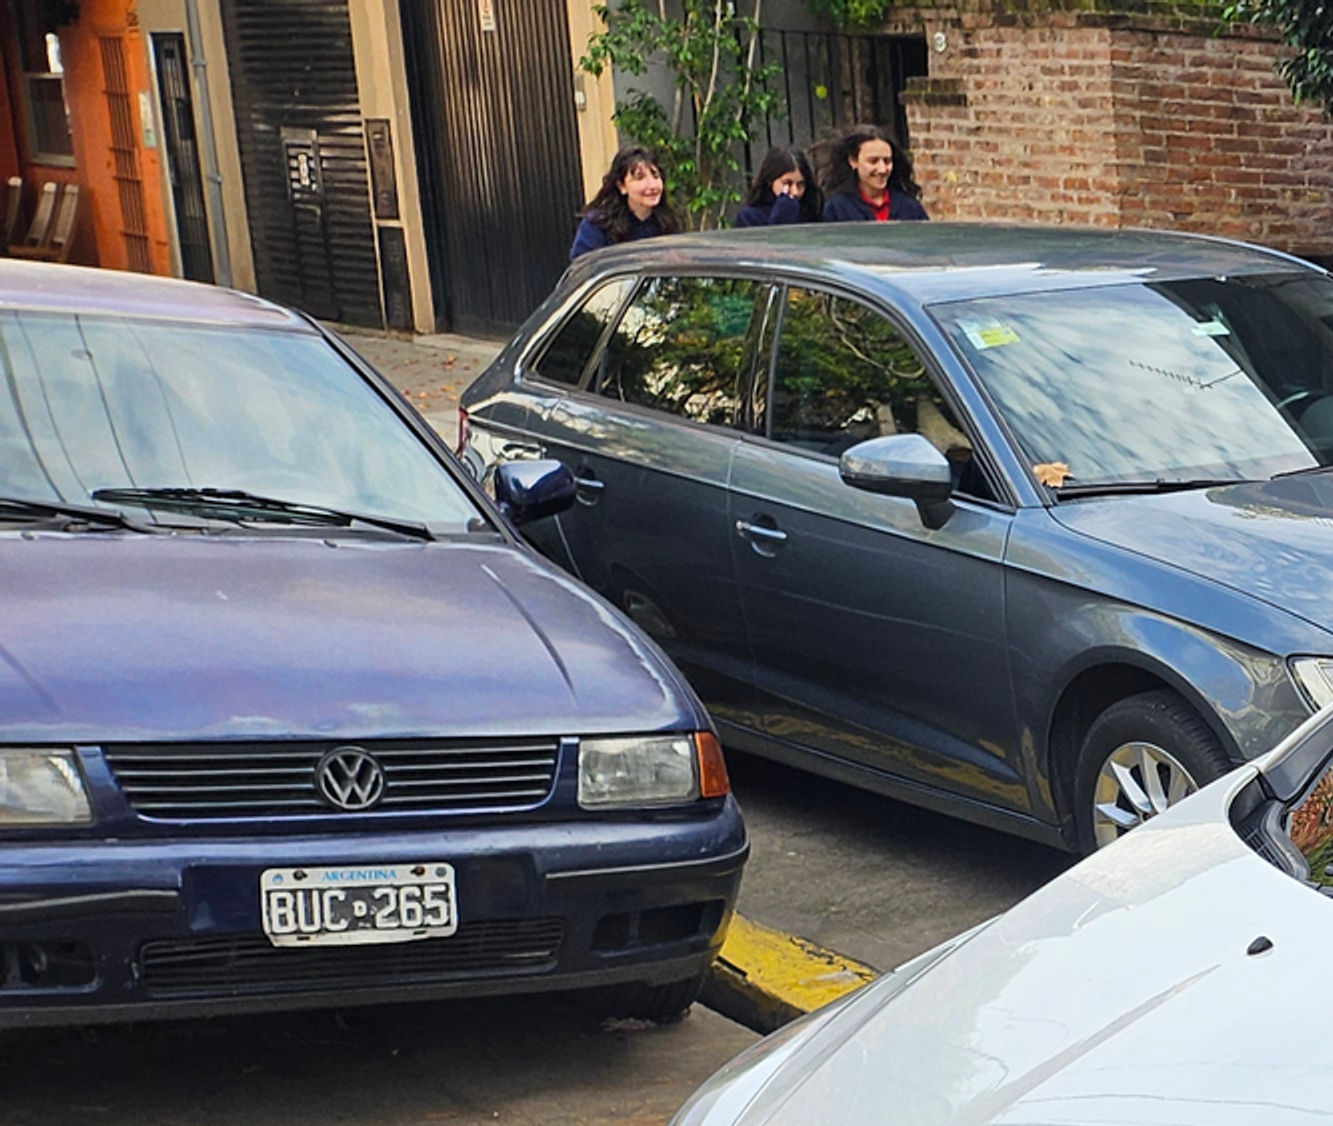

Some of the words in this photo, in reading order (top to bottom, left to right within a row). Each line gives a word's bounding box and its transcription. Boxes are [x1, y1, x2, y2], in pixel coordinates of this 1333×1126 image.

[322, 869, 398, 882] ARGENTINA
[269, 888, 349, 934] BUC
[372, 883, 450, 929] 265
